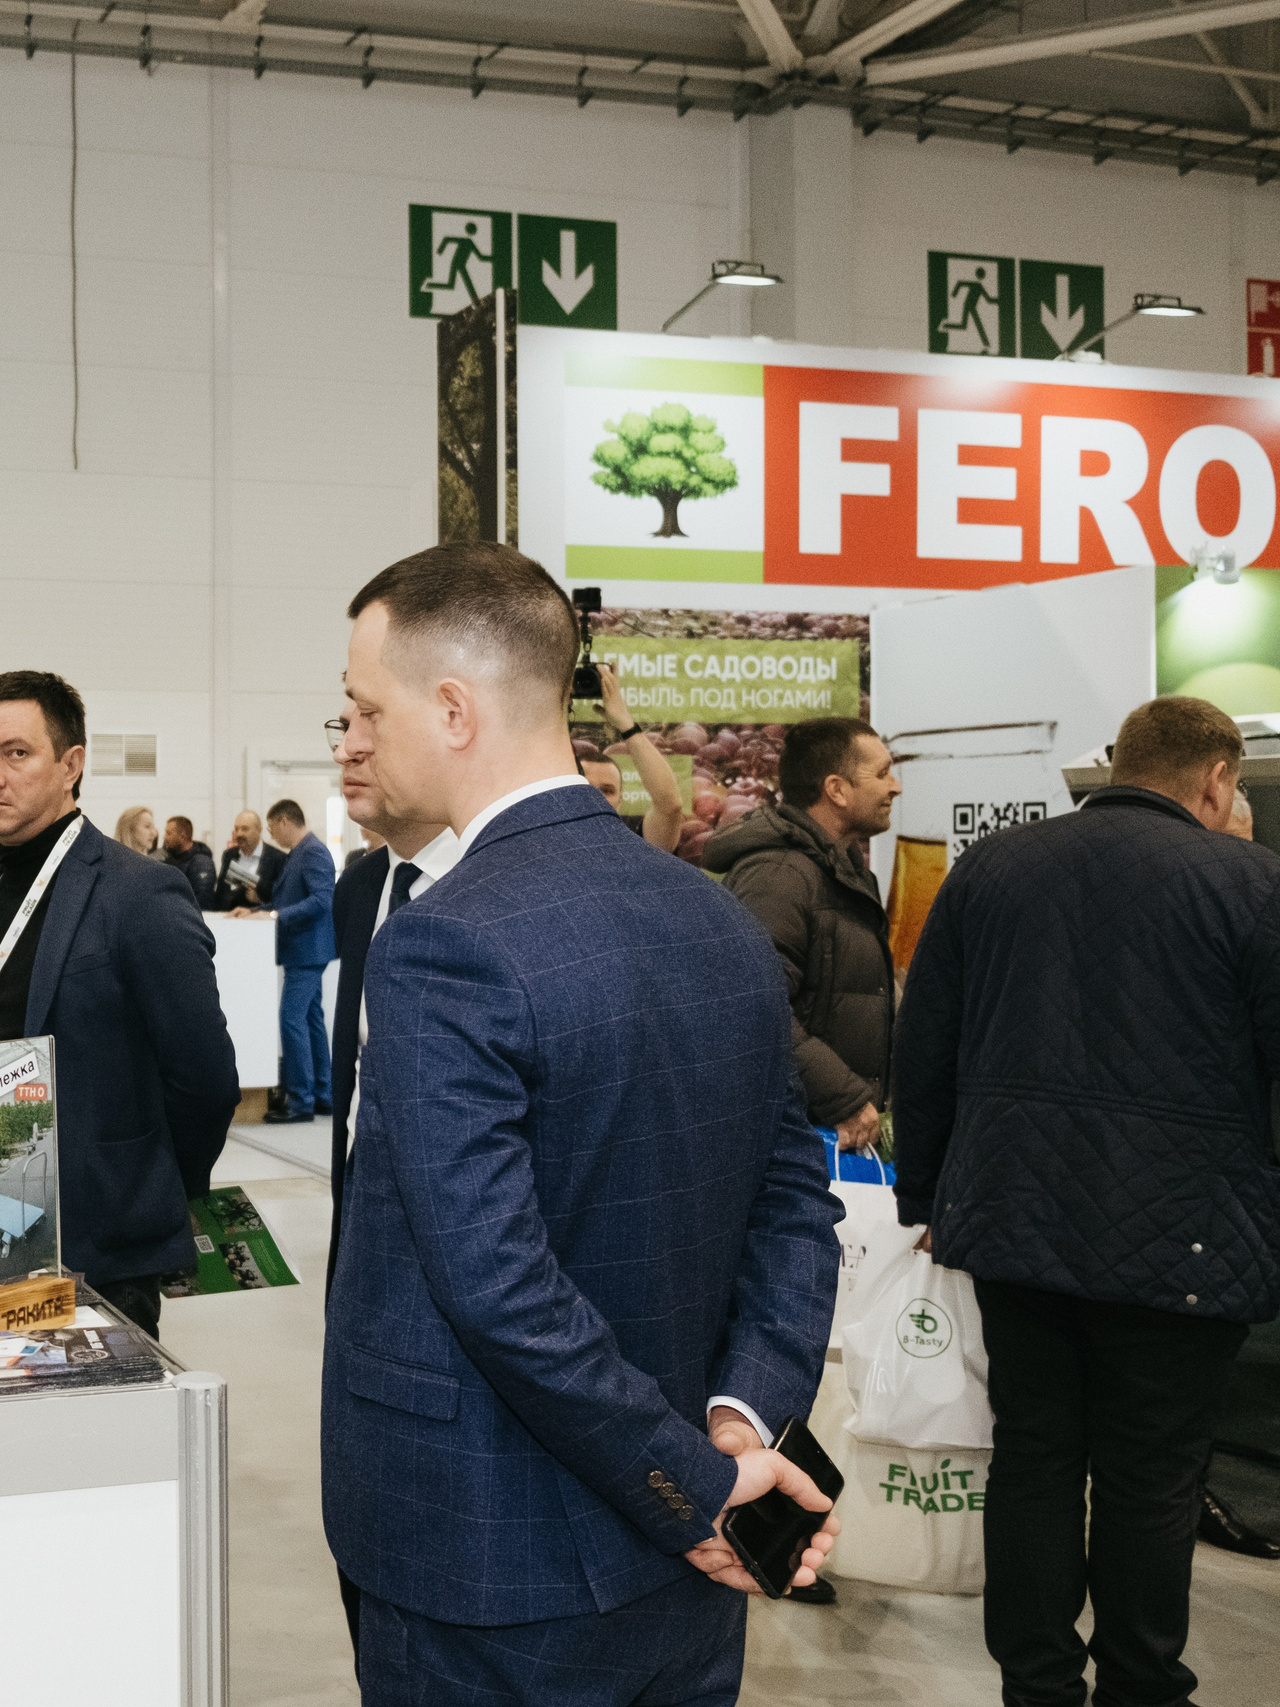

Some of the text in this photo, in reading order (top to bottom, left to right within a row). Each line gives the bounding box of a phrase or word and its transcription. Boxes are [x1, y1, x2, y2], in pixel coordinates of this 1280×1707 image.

[684, 655, 838, 682] САДОВОДЫ
[691, 687, 737, 709] ПОД
[741, 689, 832, 710] НОГАМИ!
[903, 1335, 943, 1348] B-Tasty
[879, 1482, 985, 1515] TRADE
